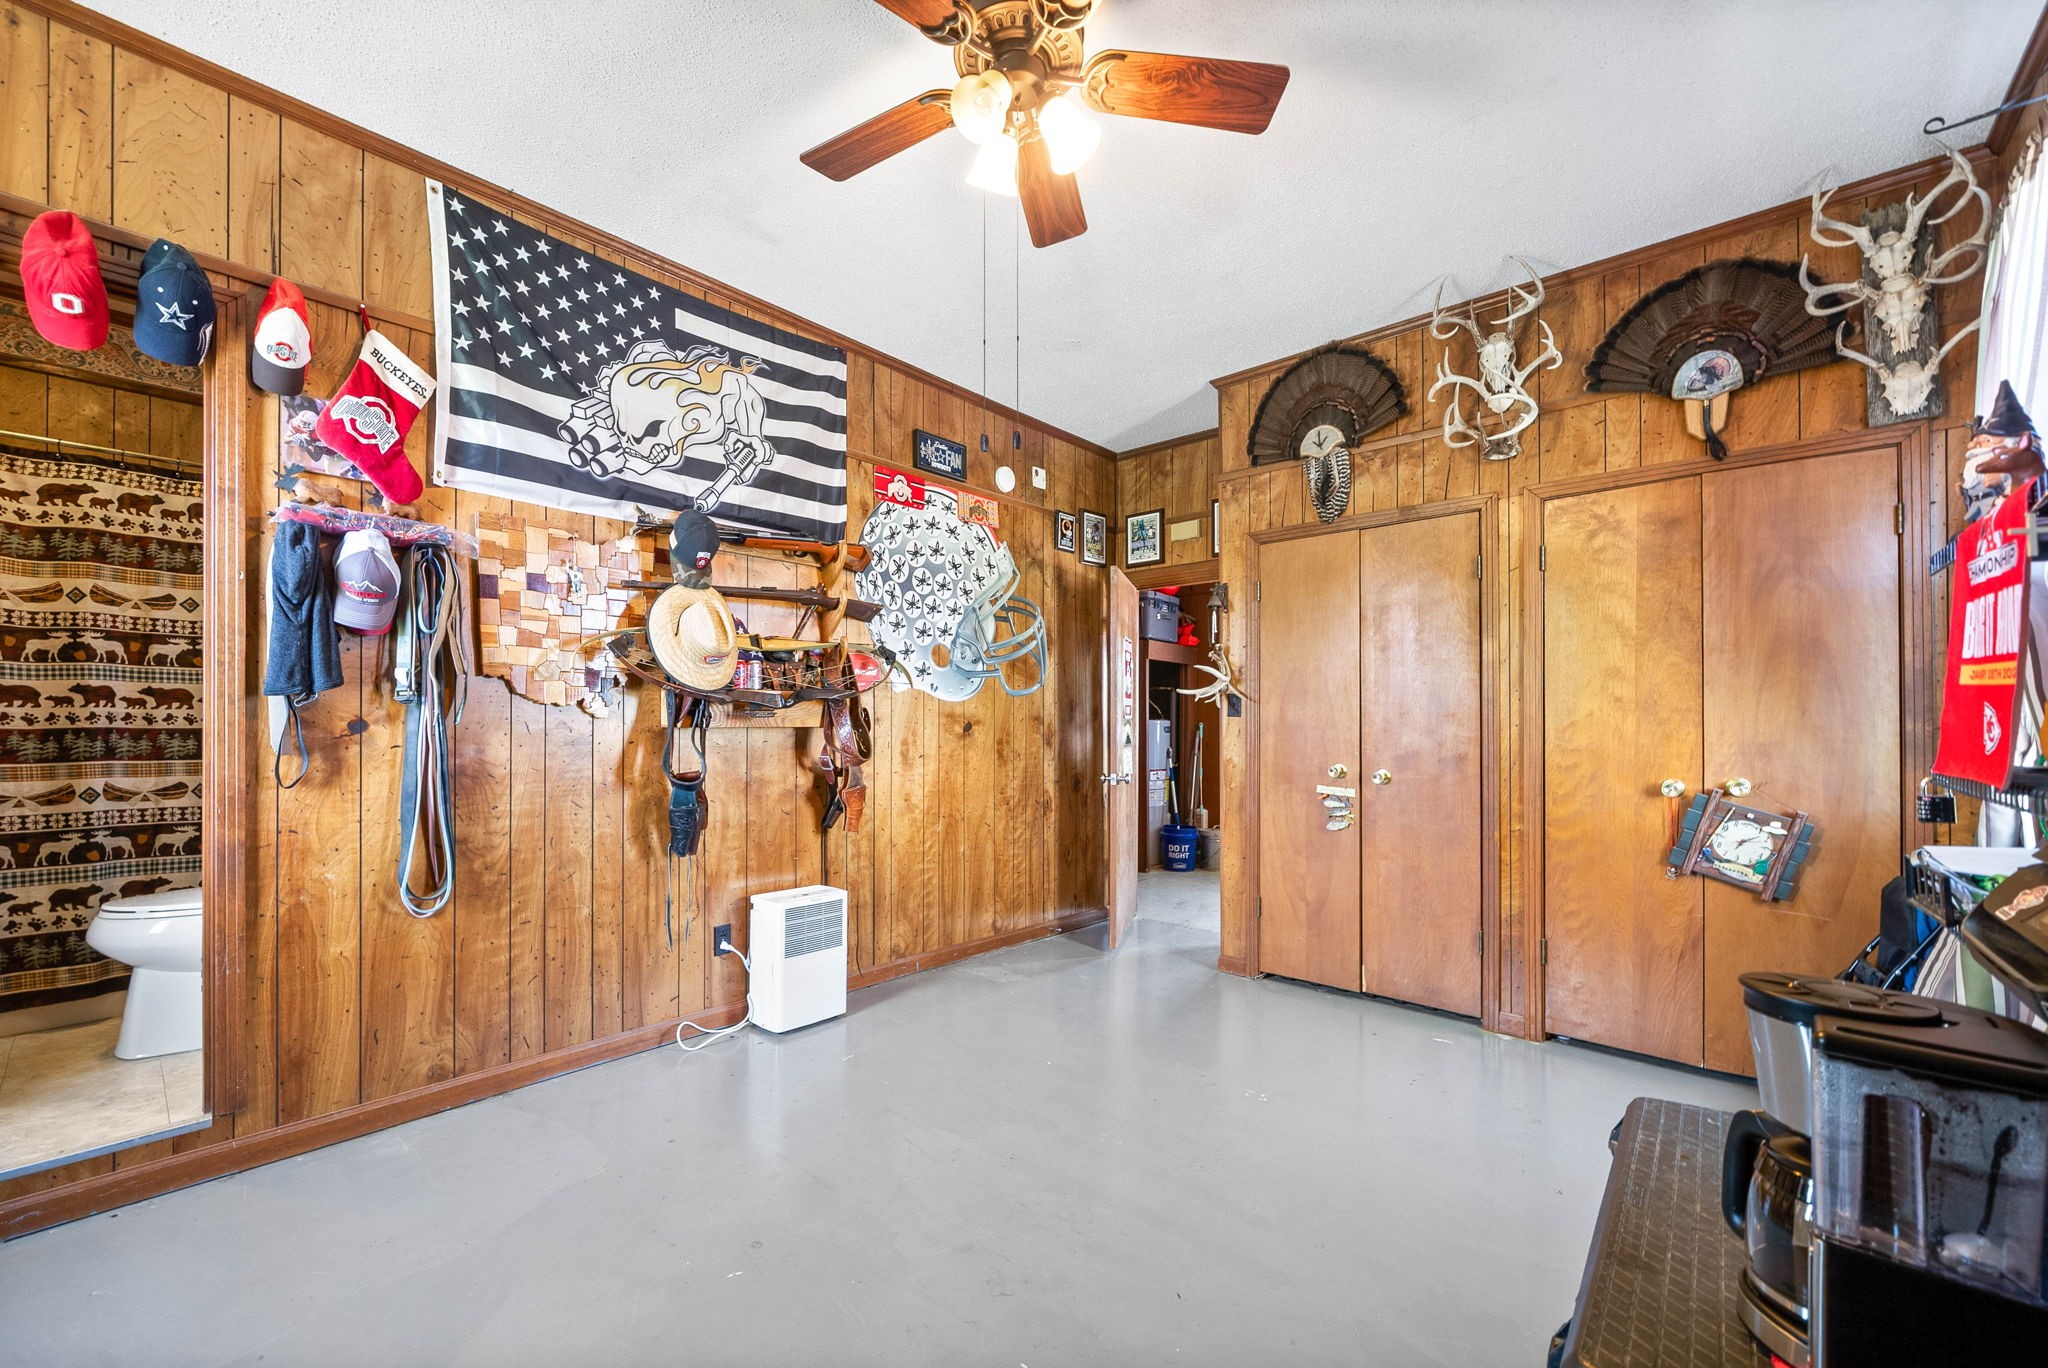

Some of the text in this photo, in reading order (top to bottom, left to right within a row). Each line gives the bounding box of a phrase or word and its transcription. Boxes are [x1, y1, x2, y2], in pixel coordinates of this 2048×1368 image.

[52, 293, 84, 315] O
[945, 449, 962, 470] FAN
[1168, 844, 1180, 852] DO
[1168, 851, 1190, 859] RIGHT
